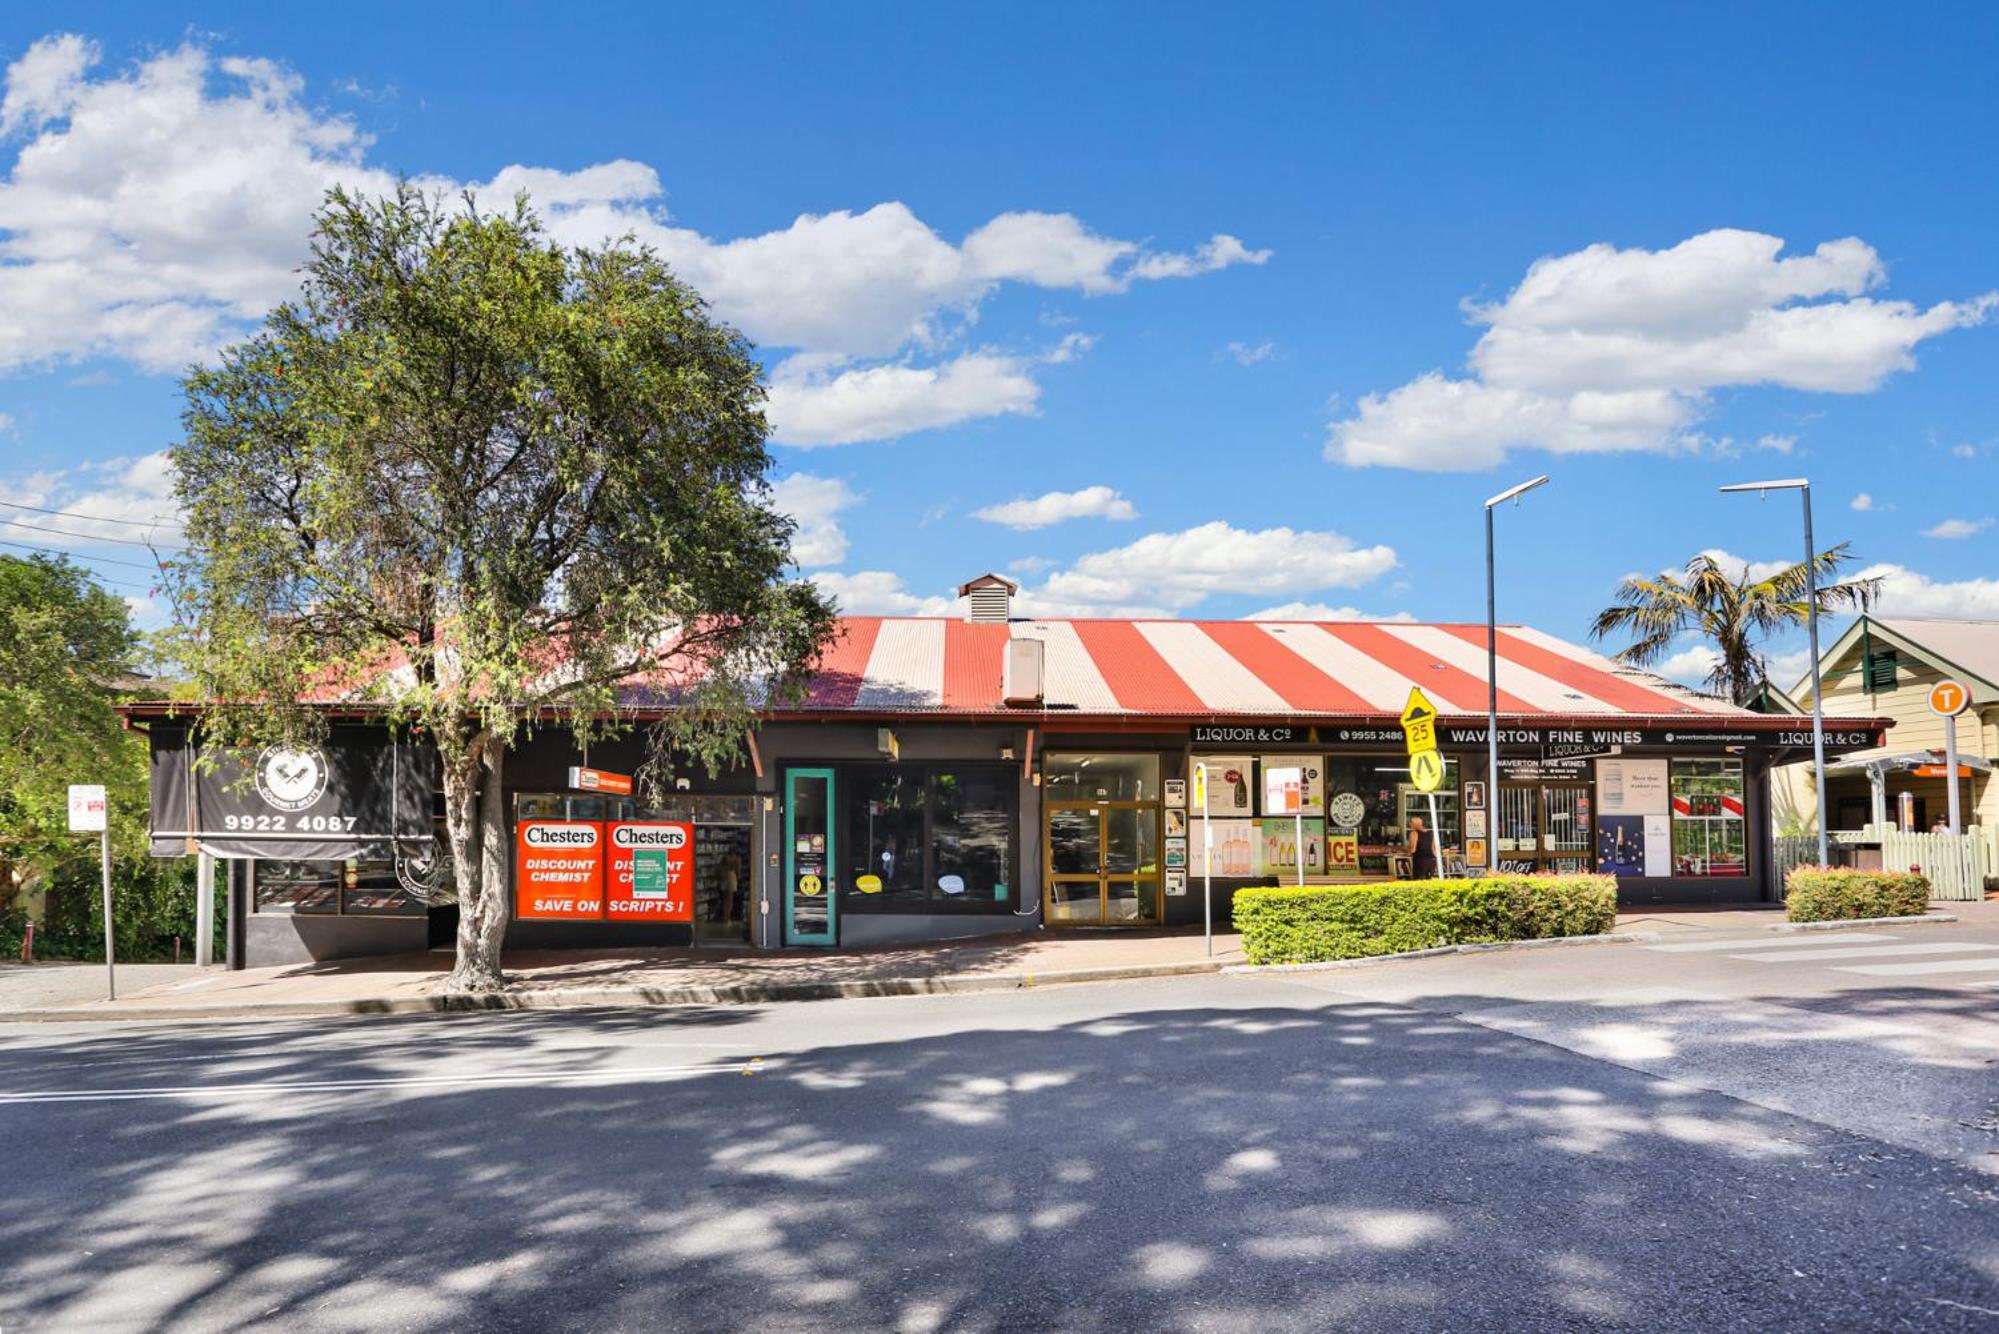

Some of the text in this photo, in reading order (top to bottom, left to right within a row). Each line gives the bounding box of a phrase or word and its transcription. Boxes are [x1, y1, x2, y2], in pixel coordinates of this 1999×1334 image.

[1939, 689, 1954, 709] T
[1196, 728, 1257, 741] LIQUOR
[1258, 728, 1270, 740] &
[1351, 731, 1403, 740] 9955 2486
[1412, 724, 1429, 742] 25
[1451, 730, 1642, 743] WAVRTON FINE WINES
[1835, 733, 1848, 744] &
[225, 815, 357, 831] 9922 4087
[527, 827, 595, 843] Chesters
[615, 828, 683, 844] Chesters
[1327, 841, 1355, 863] ICE
[526, 859, 596, 870] DISCOUNT
[530, 872, 592, 882] CHEMIST
[534, 900, 600, 912] SAVE ON
[609, 901, 675, 912] SCRIPTS
